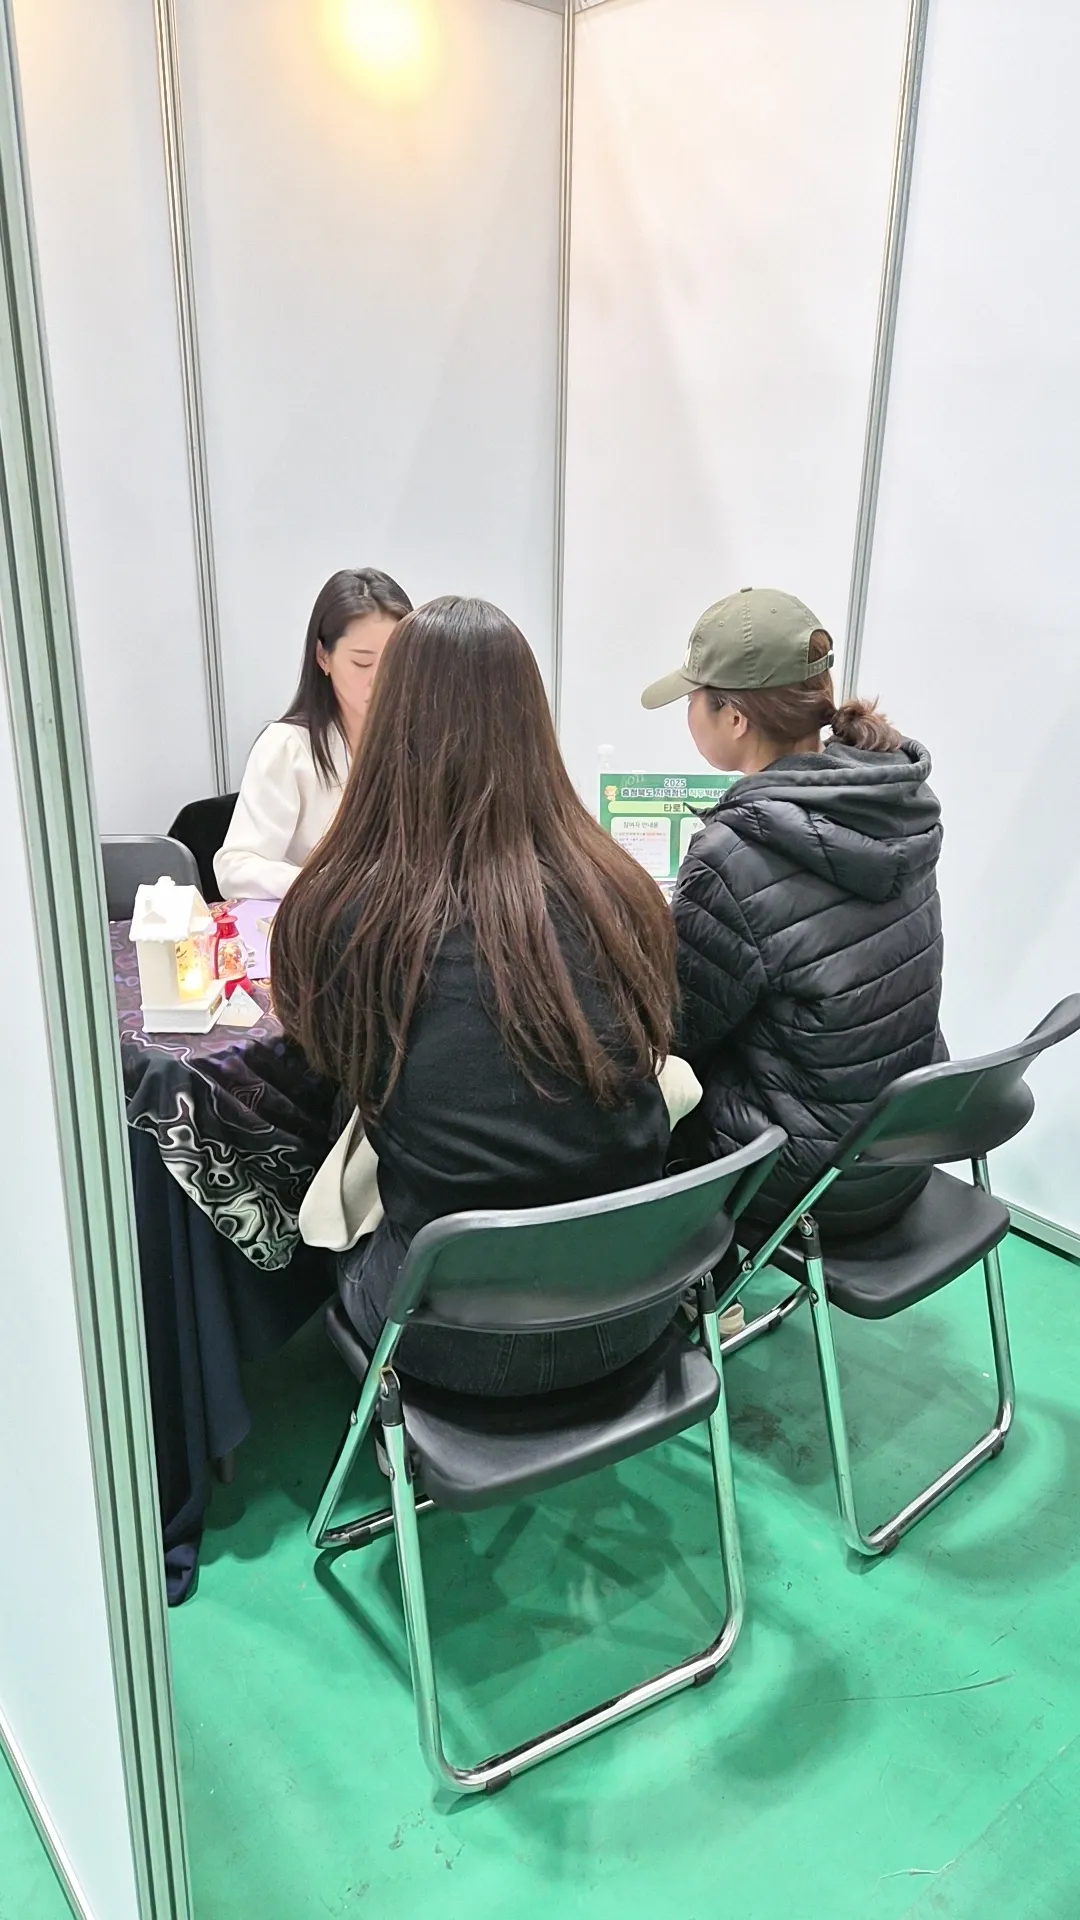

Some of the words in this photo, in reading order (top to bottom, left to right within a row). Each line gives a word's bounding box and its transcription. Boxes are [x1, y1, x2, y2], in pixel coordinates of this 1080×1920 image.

[664, 778, 686, 787] 2025
[621, 788, 653, 797] 충청북도
[654, 788, 687, 797] 지역청년
